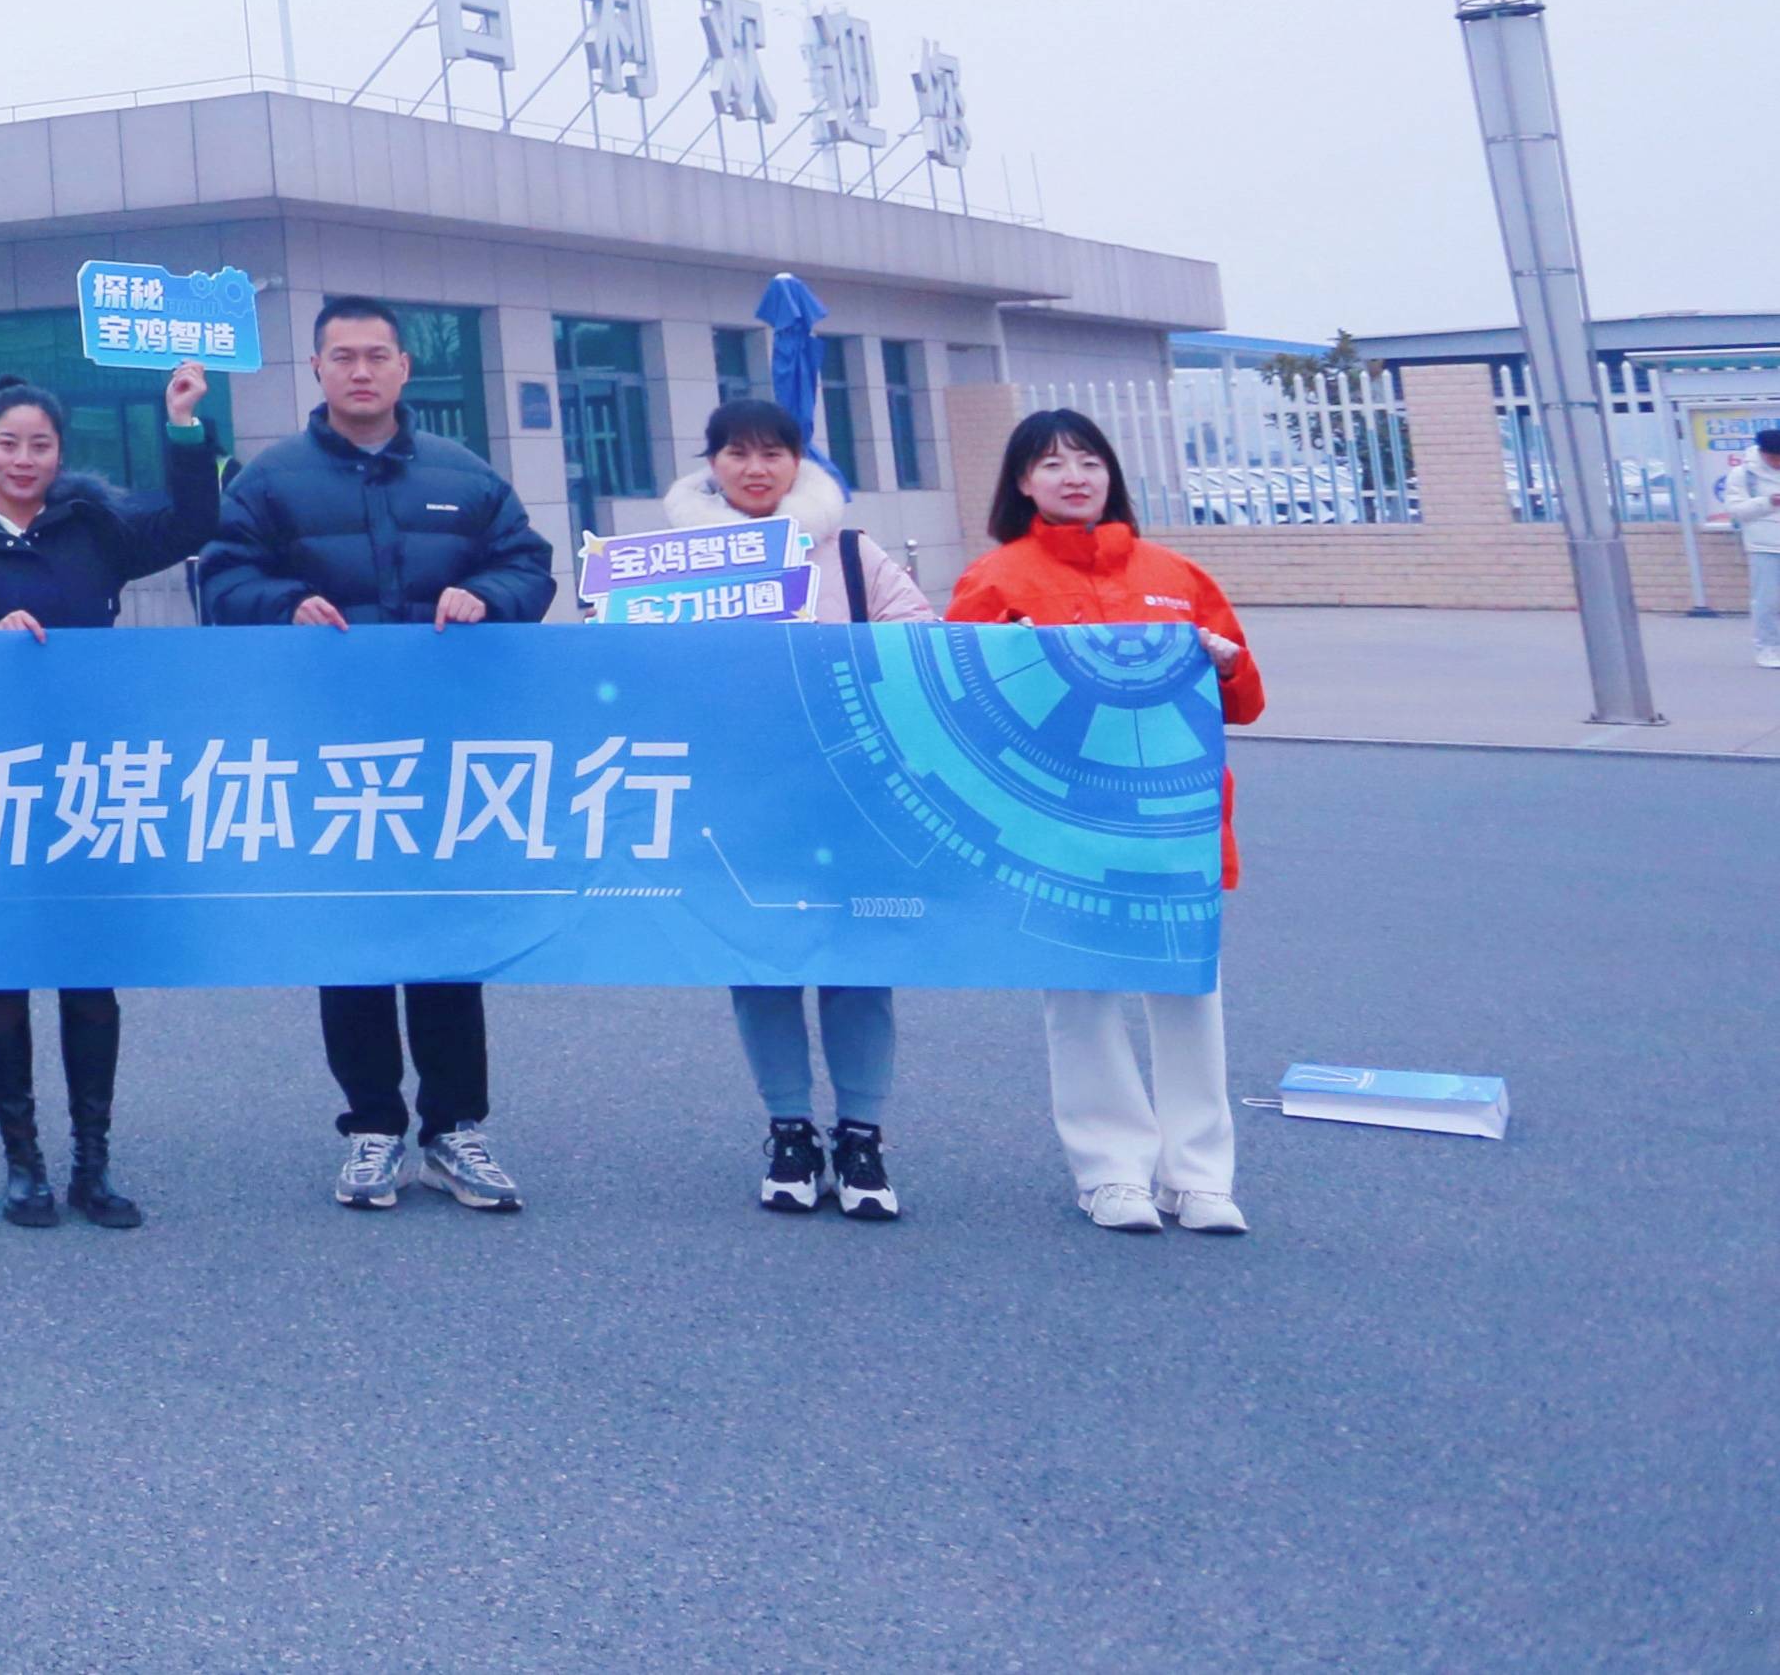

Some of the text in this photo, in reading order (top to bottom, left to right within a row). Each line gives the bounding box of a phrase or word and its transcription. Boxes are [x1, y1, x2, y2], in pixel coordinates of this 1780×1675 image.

[93, 273, 164, 312] 探秘
[97, 315, 236, 357] 宝鸡智造
[609, 530, 767, 581] 宝鸡智造
[626, 580, 785, 623] 实力出圈
